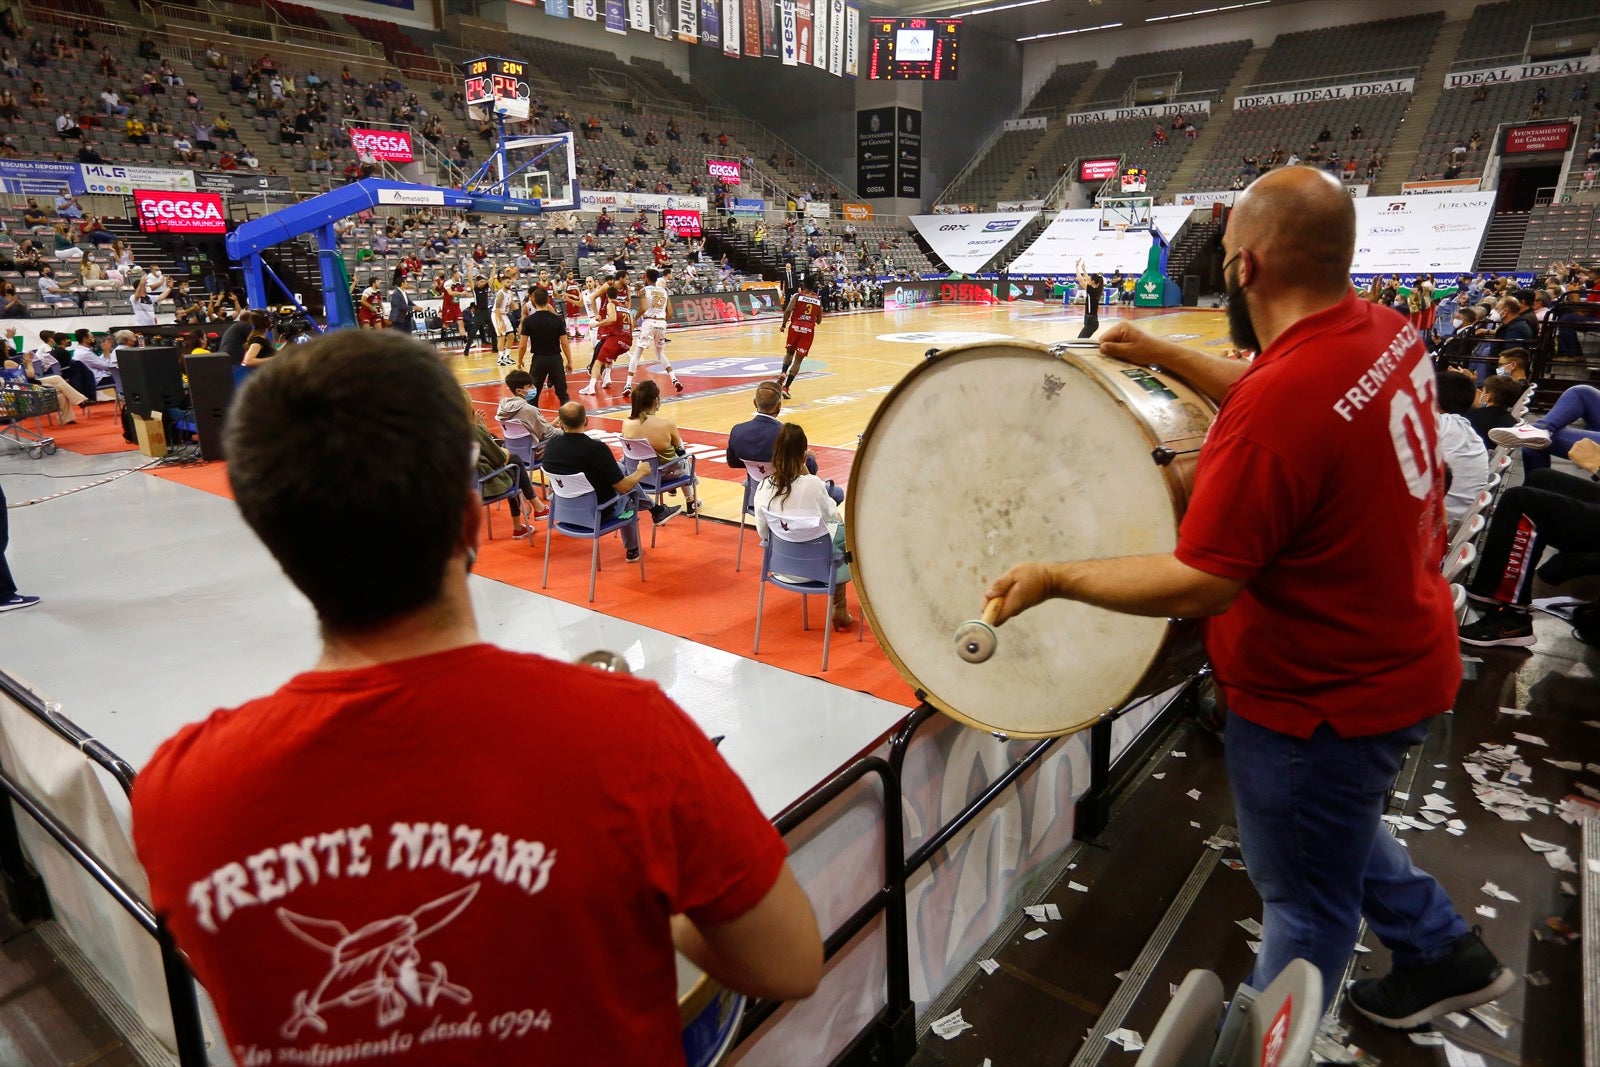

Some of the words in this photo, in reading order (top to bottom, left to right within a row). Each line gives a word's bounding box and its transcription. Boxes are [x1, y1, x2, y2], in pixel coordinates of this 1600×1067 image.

[502, 61, 523, 75] 204
[1450, 69, 1511, 87] IDEAL
[1520, 61, 1588, 80] IDEAL
[467, 80, 483, 101] 24
[494, 77, 516, 98] 24
[1238, 94, 1286, 108] IDEAL
[1292, 87, 1345, 103] IDEAL
[1351, 81, 1407, 96] IDEAL
[1070, 112, 1109, 125] IDEAL
[1116, 107, 1156, 120] IDEAL
[1163, 103, 1206, 115] IDEAL
[1512, 127, 1567, 137] AYUNTAMIENTO
[1526, 135, 1560, 143] GRANADA
[0, 161, 33, 169] ESCUELA
[35, 163, 75, 171] DEPORTIVA
[595, 196, 617, 205] MARCA
[1196, 194, 1228, 202] MANZANO
[1434, 201, 1488, 211] JURAND
[682, 294, 745, 323] Digital
[804, 303, 813, 315] 3
[1332, 350, 1398, 423] FRENTE
[1503, 529, 1529, 580] GRANADA
[278, 1030, 413, 1066] sentimiento
[419, 1011, 482, 1045] desde
[488, 1008, 552, 1040] 1994
